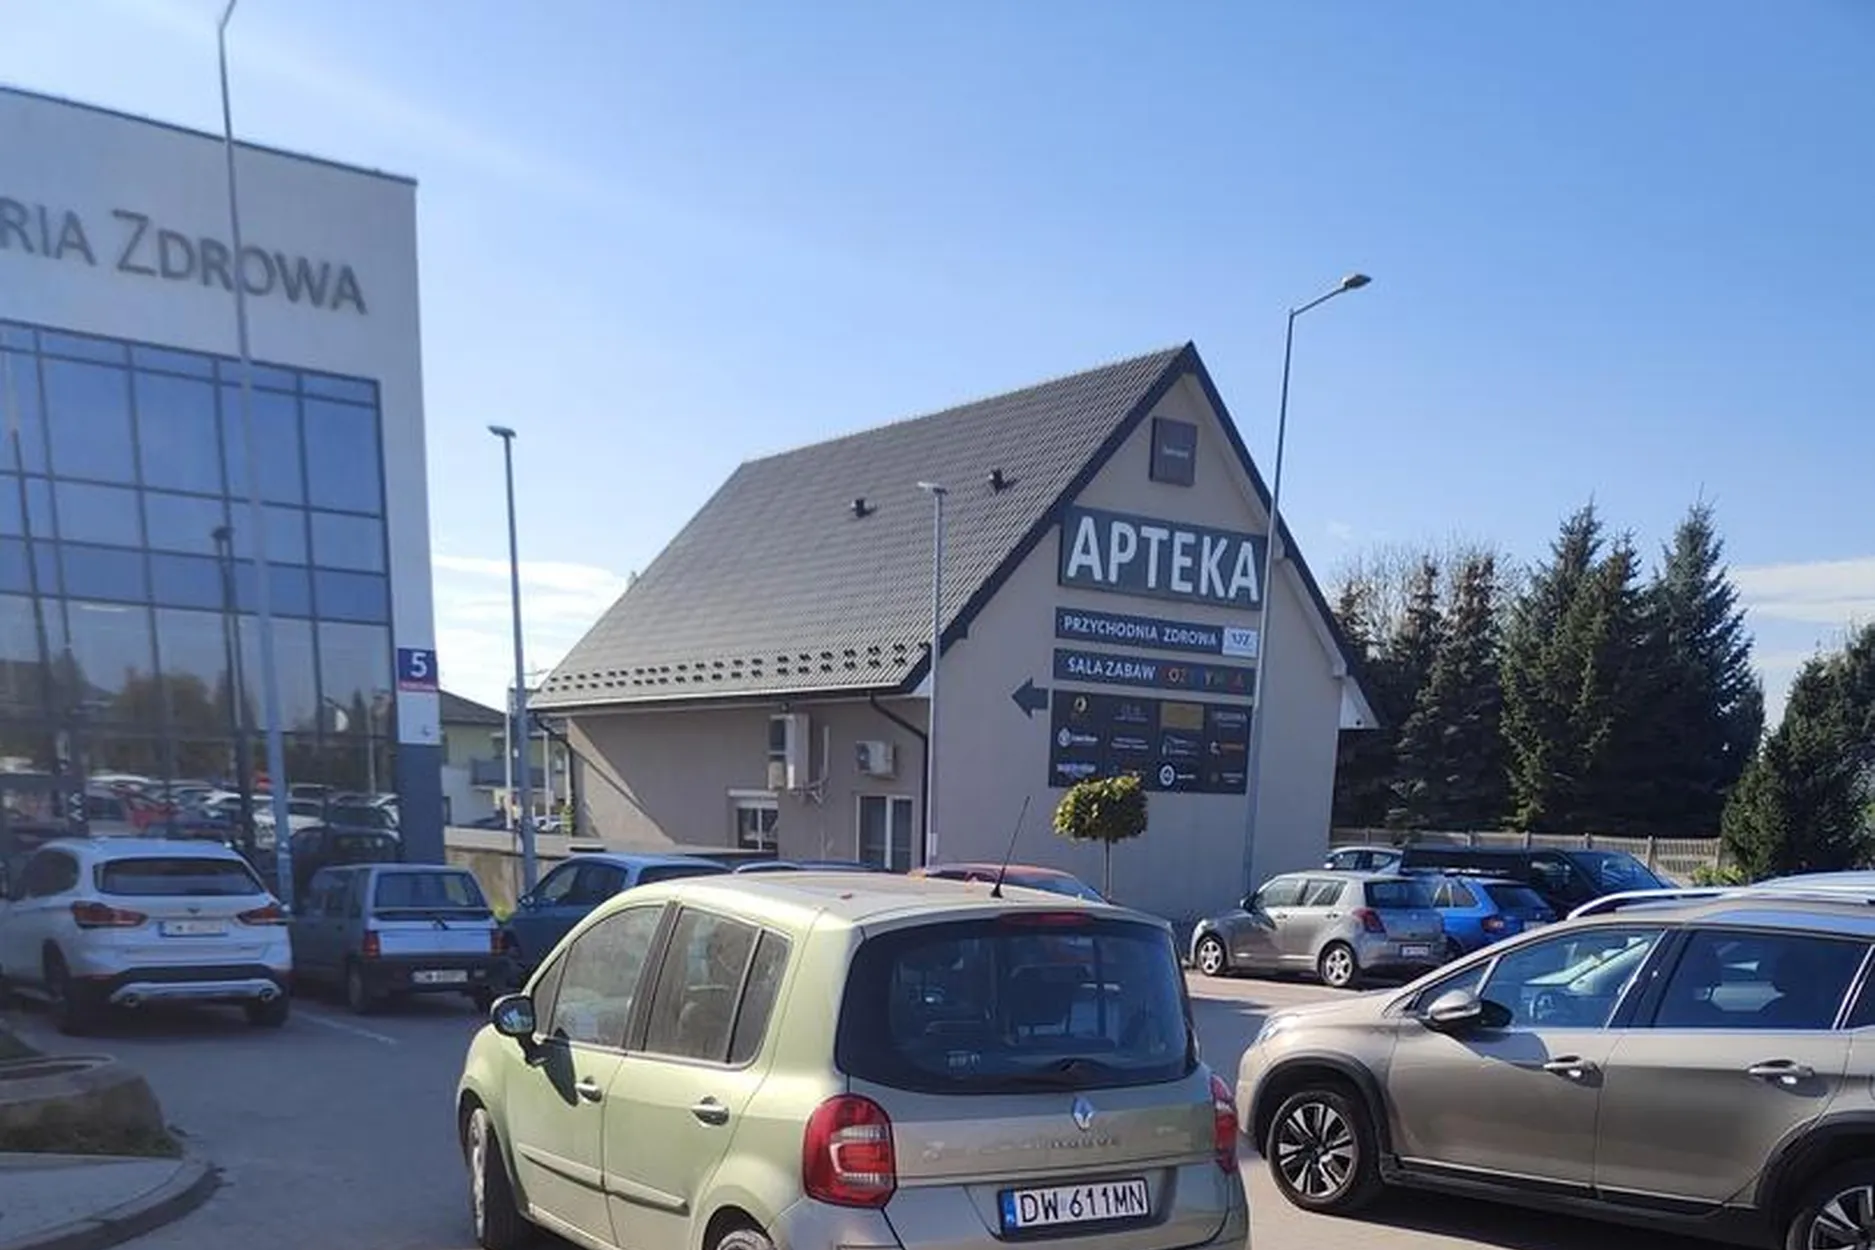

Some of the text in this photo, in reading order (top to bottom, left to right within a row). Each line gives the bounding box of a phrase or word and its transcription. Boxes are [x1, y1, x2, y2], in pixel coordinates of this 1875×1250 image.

[111, 208, 369, 315] ZDROWA
[1067, 515, 1259, 602] APTEKA
[1064, 615, 1158, 640] PRZYCHODNIA
[1163, 627, 1217, 647] ZDROWA
[410, 651, 428, 678] 5
[1068, 656, 1103, 675] SALA
[1105, 661, 1156, 680] ZABAW
[1020, 1184, 1144, 1223] DW 611MN
